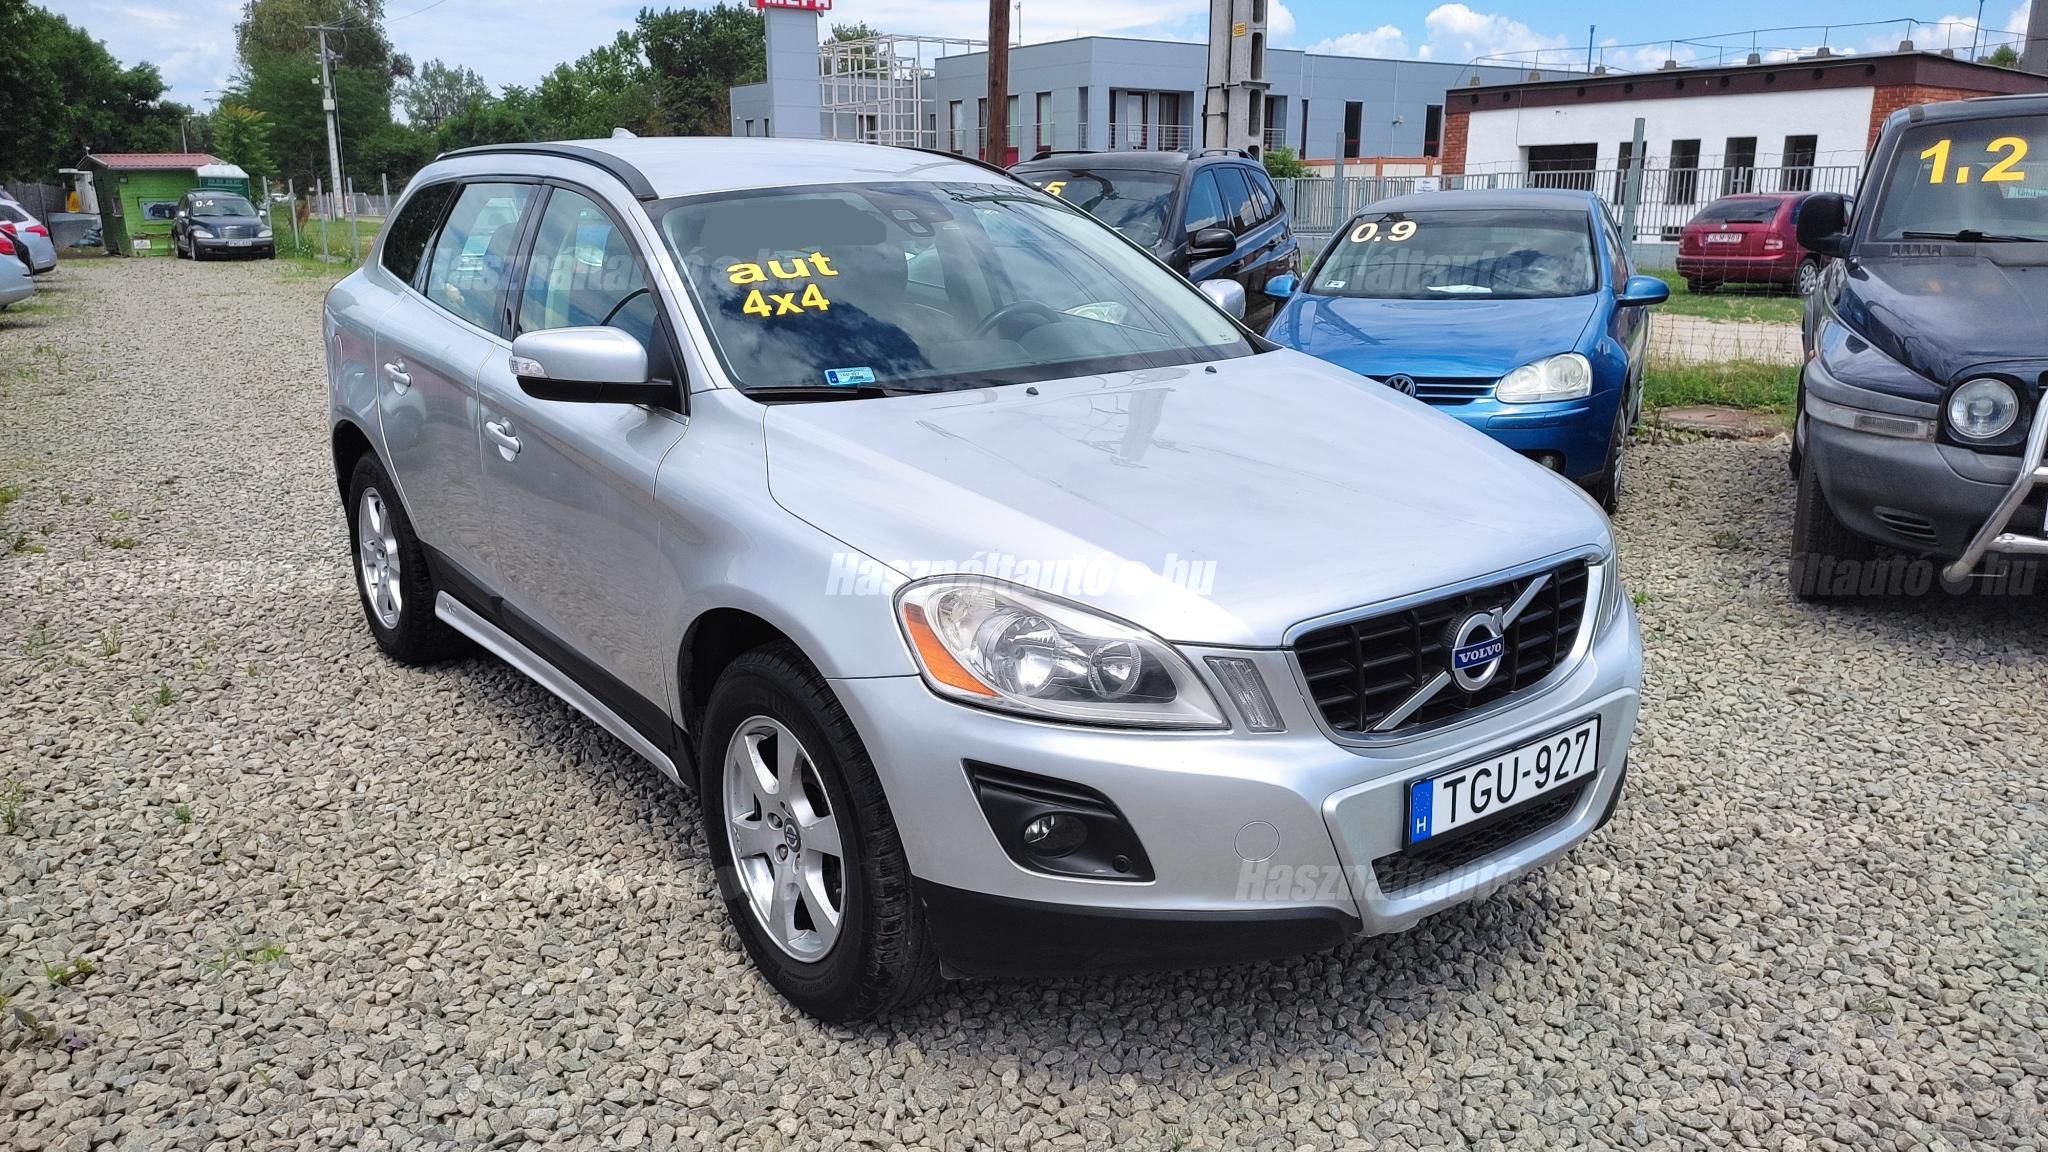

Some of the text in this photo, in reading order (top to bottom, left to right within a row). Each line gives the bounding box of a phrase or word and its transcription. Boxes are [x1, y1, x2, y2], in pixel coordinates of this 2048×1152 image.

[1920, 136, 2028, 184] 1.2
[1350, 221, 1418, 243] 0.9
[726, 251, 840, 285] aut
[742, 283, 831, 317] 4x4
[1458, 642, 1502, 664] VOLVO
[1416, 727, 1592, 834] H TGU-927
